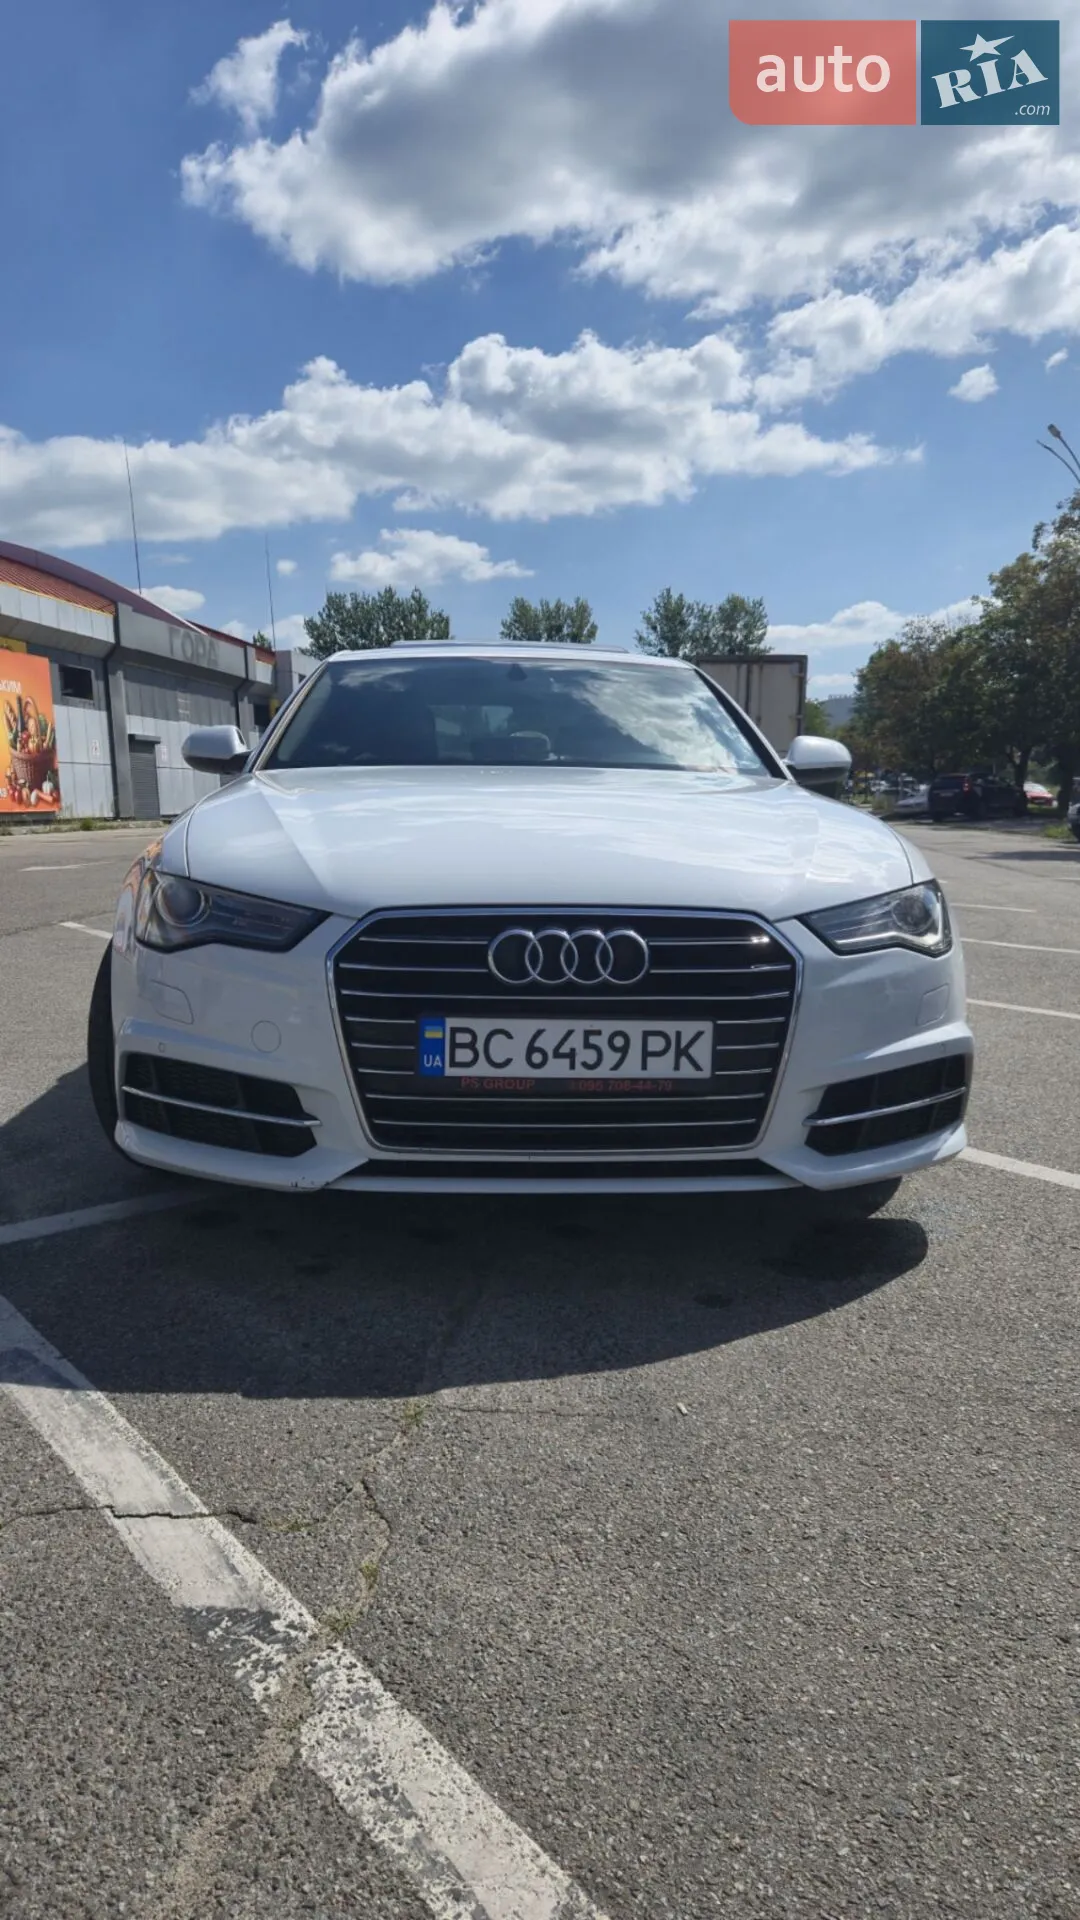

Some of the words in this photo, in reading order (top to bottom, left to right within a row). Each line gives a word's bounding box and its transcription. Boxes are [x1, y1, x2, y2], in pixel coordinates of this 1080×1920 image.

[448, 1026, 515, 1070] BC
[524, 1028, 632, 1071] 6459
[640, 1029, 706, 1072] PK
[423, 1053, 443, 1068] UA
[460, 1077, 480, 1088] PS
[482, 1078, 536, 1090] GROUP
